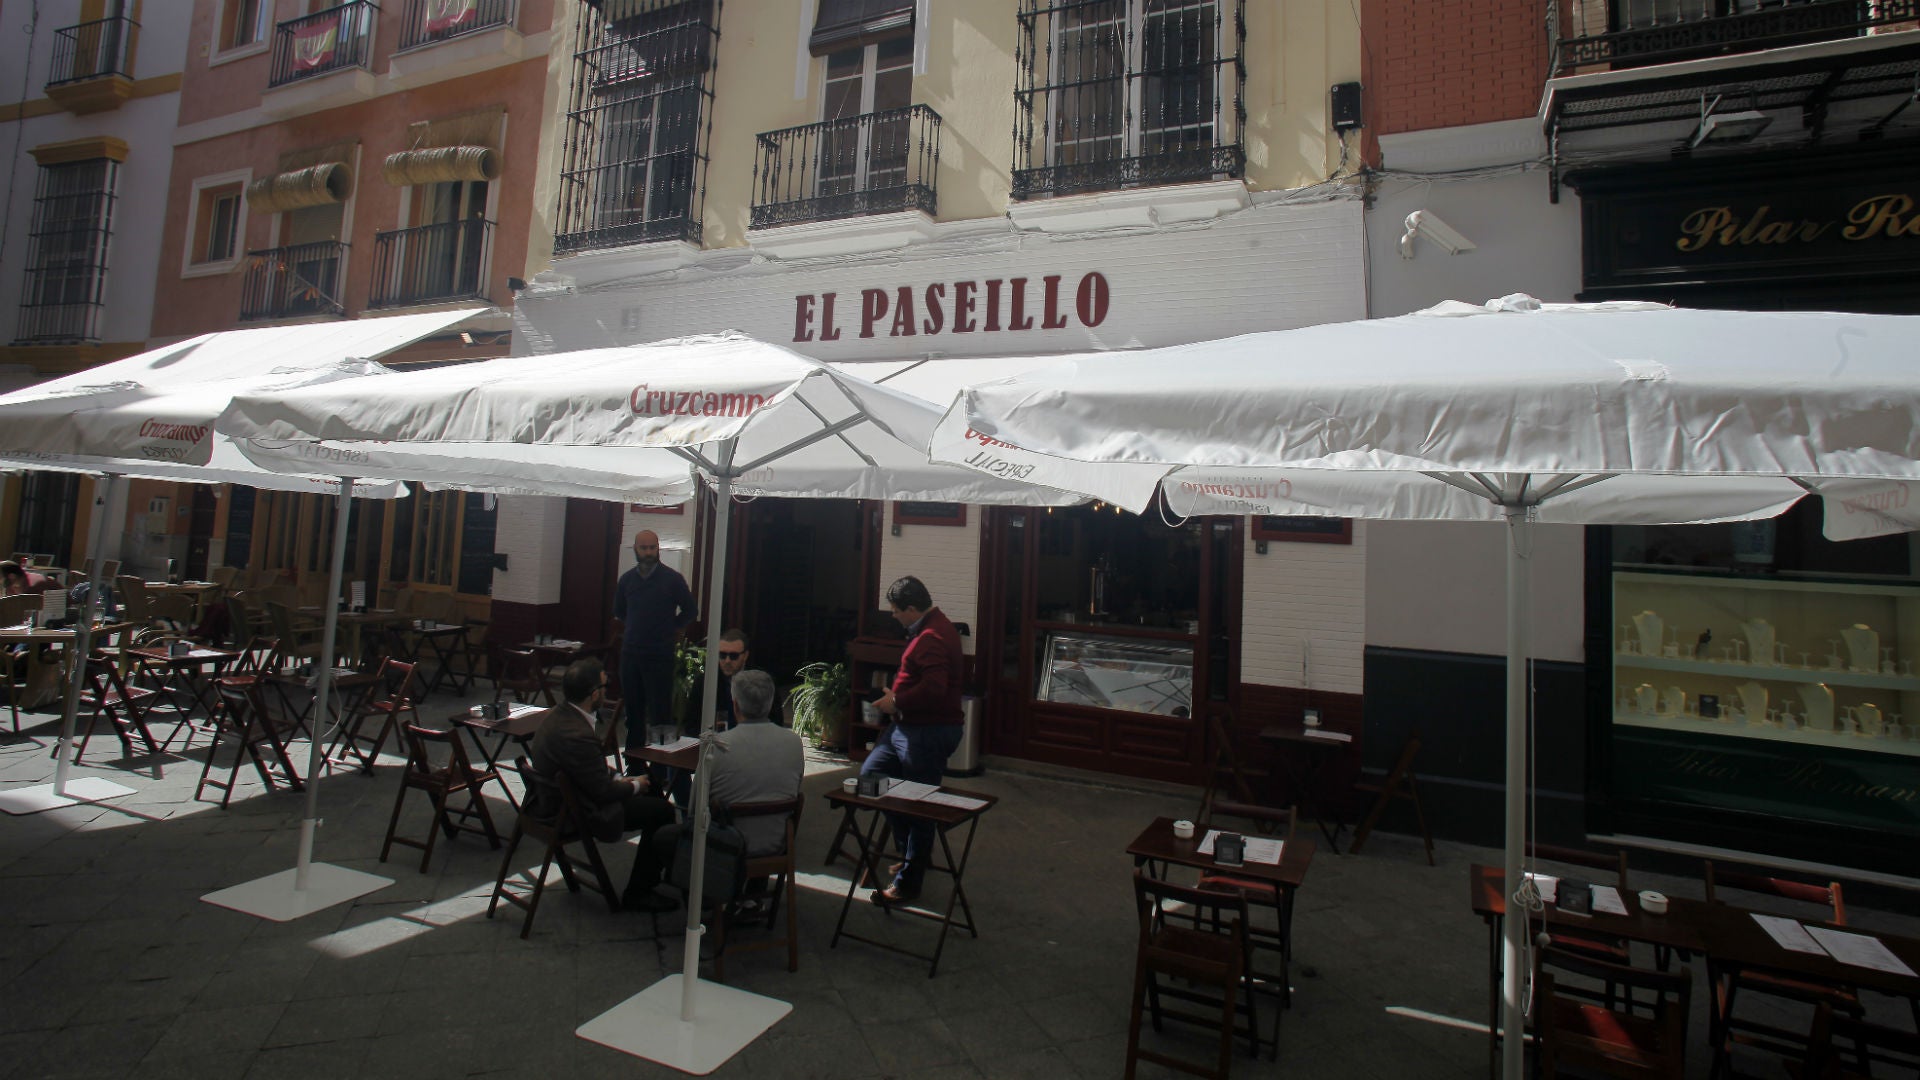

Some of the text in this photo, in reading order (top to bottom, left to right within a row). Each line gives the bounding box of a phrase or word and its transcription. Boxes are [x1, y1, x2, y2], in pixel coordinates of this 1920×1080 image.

[1676, 206, 1836, 252] Pilar
[792, 271, 1110, 342] EL PASEILLO
